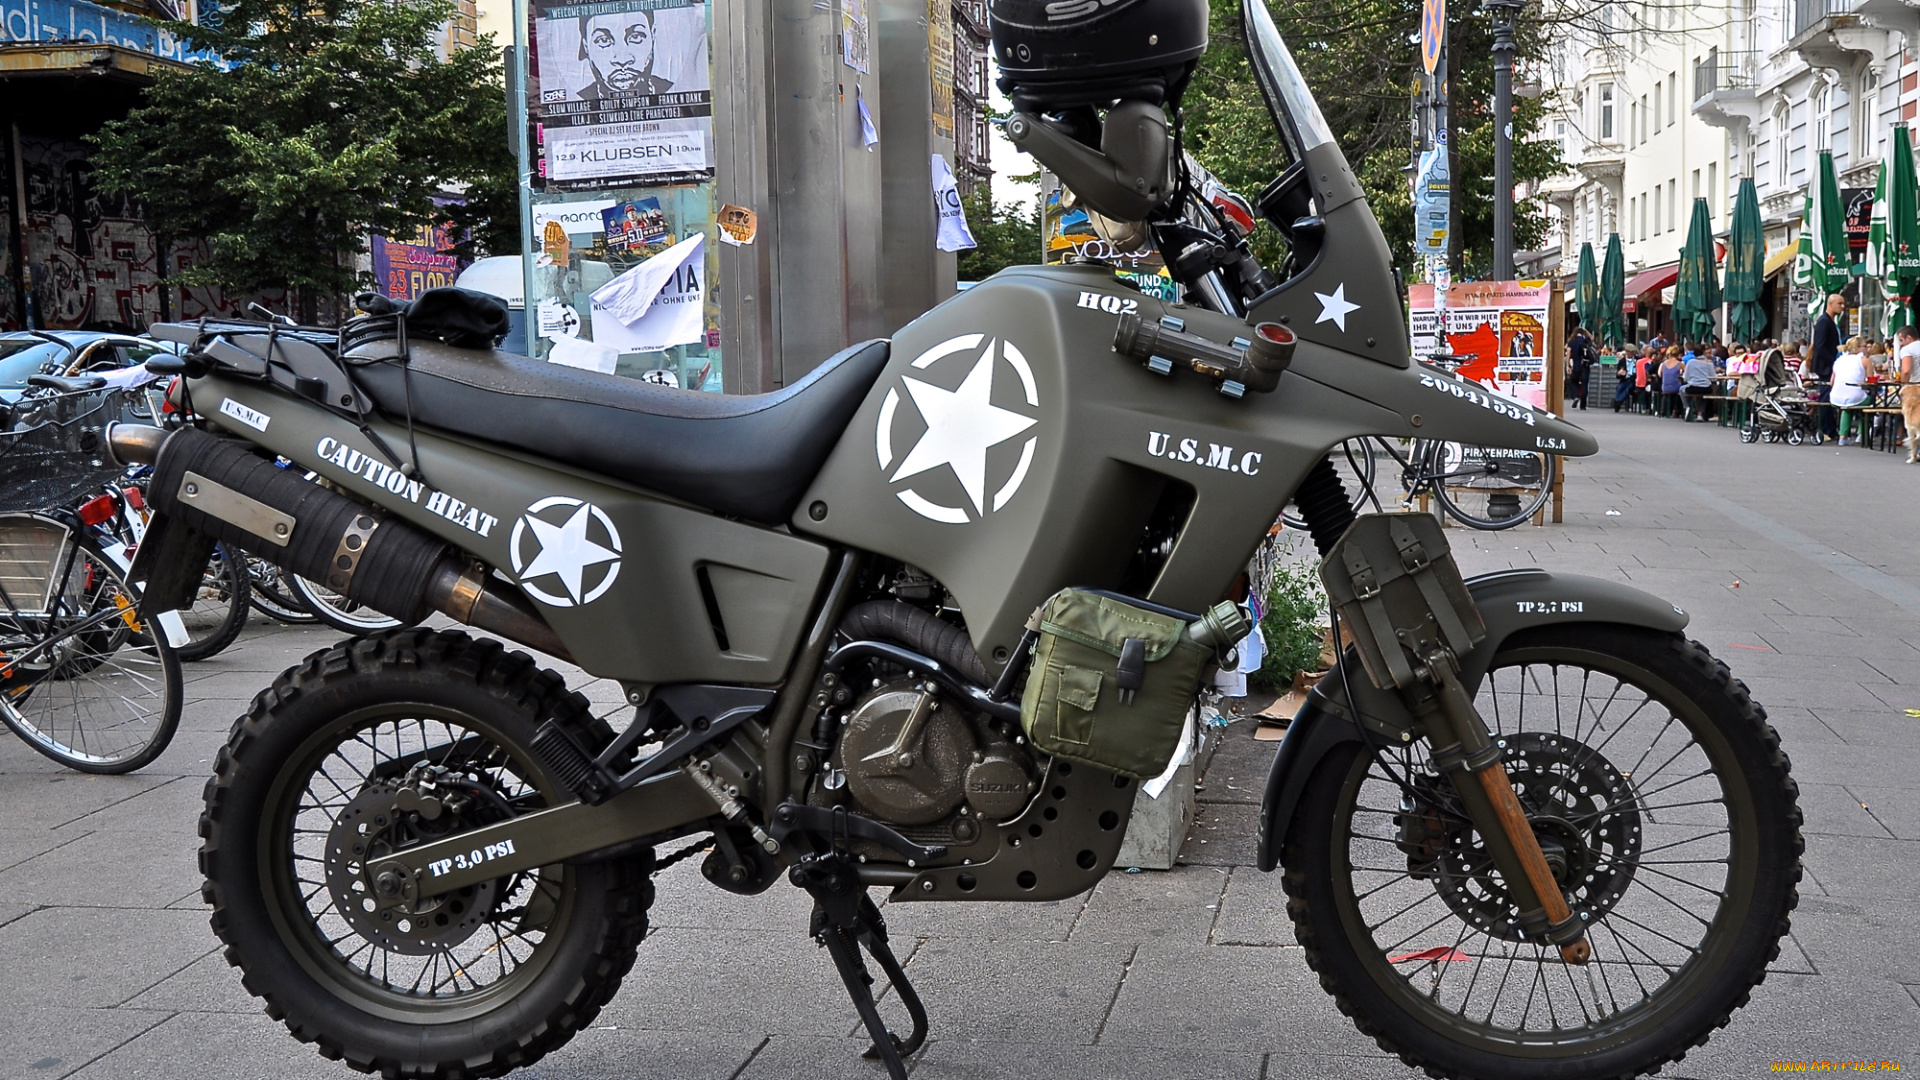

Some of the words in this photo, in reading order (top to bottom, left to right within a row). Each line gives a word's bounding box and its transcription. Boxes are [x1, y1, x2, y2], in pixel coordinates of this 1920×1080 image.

[551, 6, 580, 18] WELCOME
[581, 5, 588, 15] TO
[548, 104, 566, 114] SLUM
[566, 101, 591, 112] VILLAGE
[600, 99, 620, 110] GUILTY
[621, 96, 650, 108] SIMPSON
[658, 94, 678, 105] FRANK
[685, 92, 702, 103] DANK
[571, 115, 586, 125] ILLA
[581, 145, 672, 162] KLUBSEN
[389, 270, 407, 292] 23
[662, 296, 685, 304] OHNE
[688, 294, 700, 303] UNS
[1077, 291, 1138, 314] HQ2
[1413, 323, 1428, 331] IHR
[1455, 322, 1473, 330] UNS
[225, 400, 264, 426] U.S.M.C
[1536, 436, 1567, 450] U.S.A
[1147, 431, 1262, 476] U.S.M.C
[317, 436, 425, 503] CAUTION
[425, 491, 498, 538] HEAT
[1516, 601, 1535, 613] TP
[1537, 601, 1557, 614] 2,7
[1561, 601, 1583, 613] PSI
[970, 782, 1023, 794] SUZUKI
[428, 858, 452, 877] TP
[455, 849, 483, 869] 3,0
[484, 839, 516, 860] PSI
